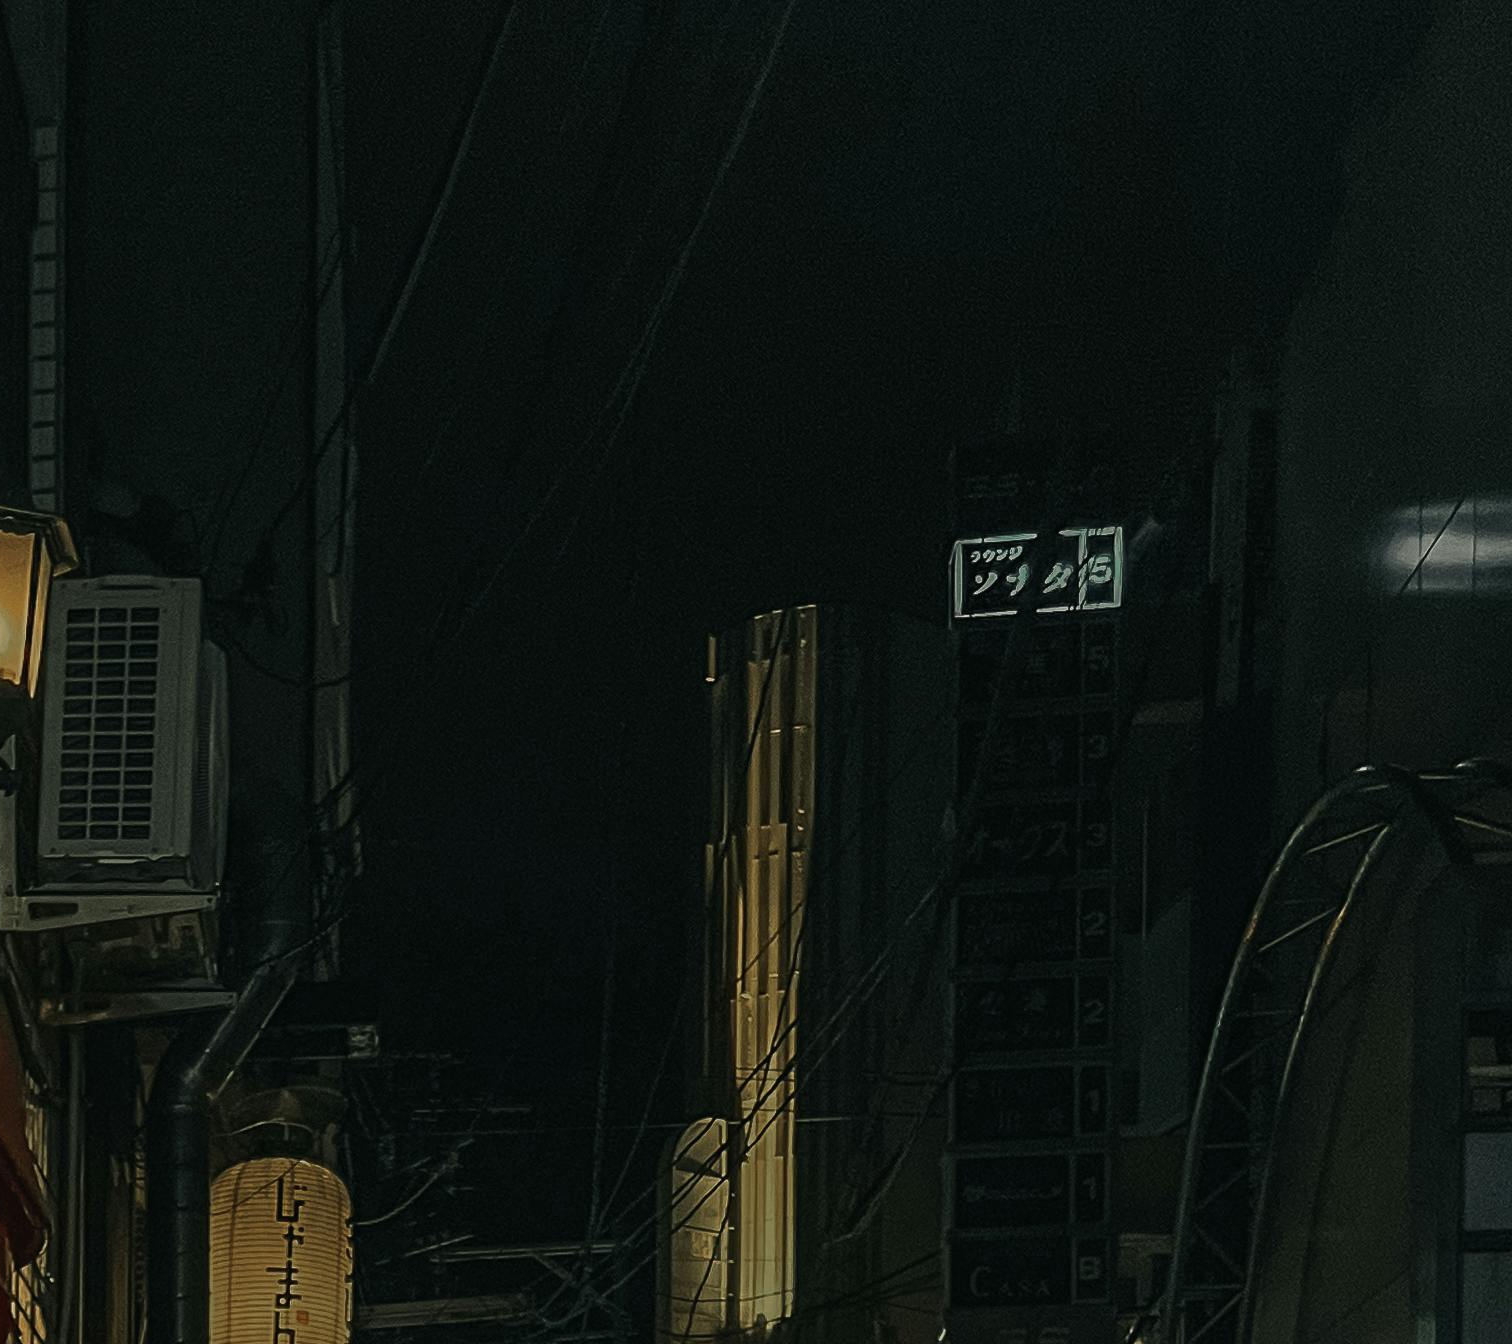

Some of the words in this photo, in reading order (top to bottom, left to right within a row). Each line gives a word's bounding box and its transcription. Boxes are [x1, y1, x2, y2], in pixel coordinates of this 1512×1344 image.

[973, 562, 1075, 597] ソナタ
[1082, 911, 1107, 938] 2
[1081, 999, 1105, 1025] 2
